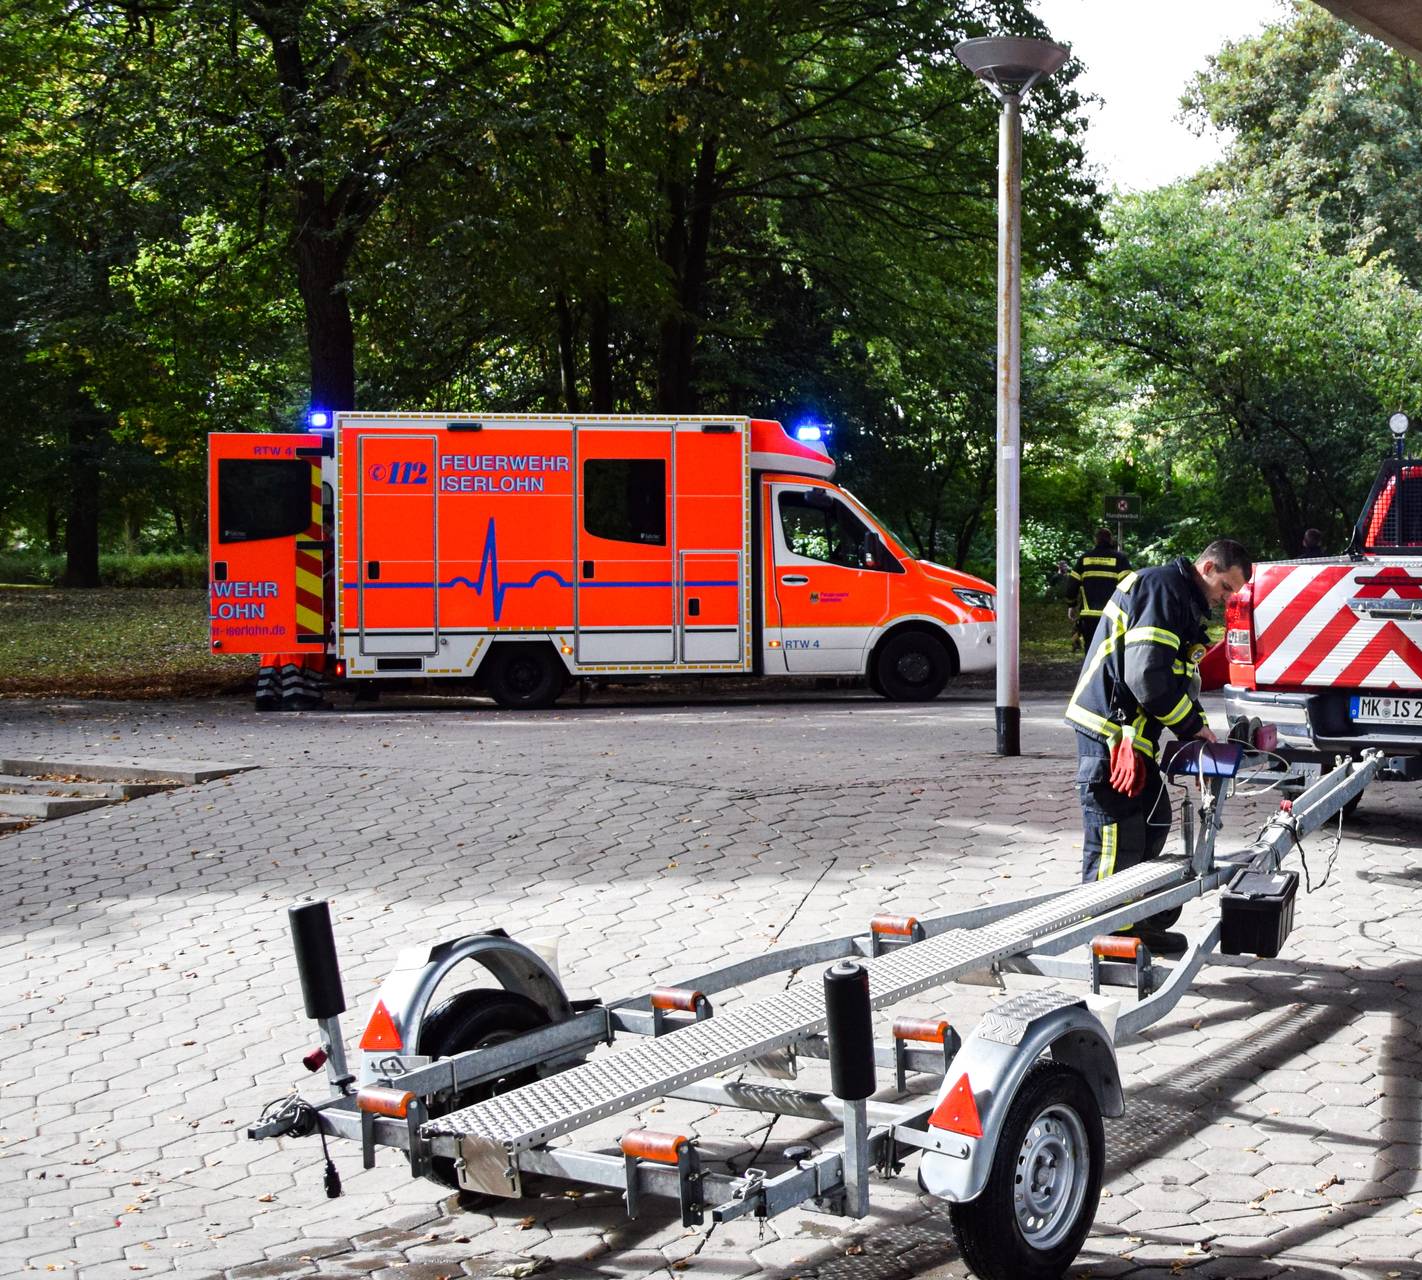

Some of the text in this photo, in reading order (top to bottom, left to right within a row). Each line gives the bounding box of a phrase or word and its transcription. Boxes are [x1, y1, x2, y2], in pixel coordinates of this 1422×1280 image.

[254, 446, 293, 456] RTW 4
[440, 455, 570, 472] FEUERWEHR
[386, 461, 429, 485] 112
[440, 476, 545, 492] ISERLOHN
[785, 640, 821, 650] RTW 4
[1361, 699, 1381, 717] MK
[1392, 700, 1410, 718] IS
